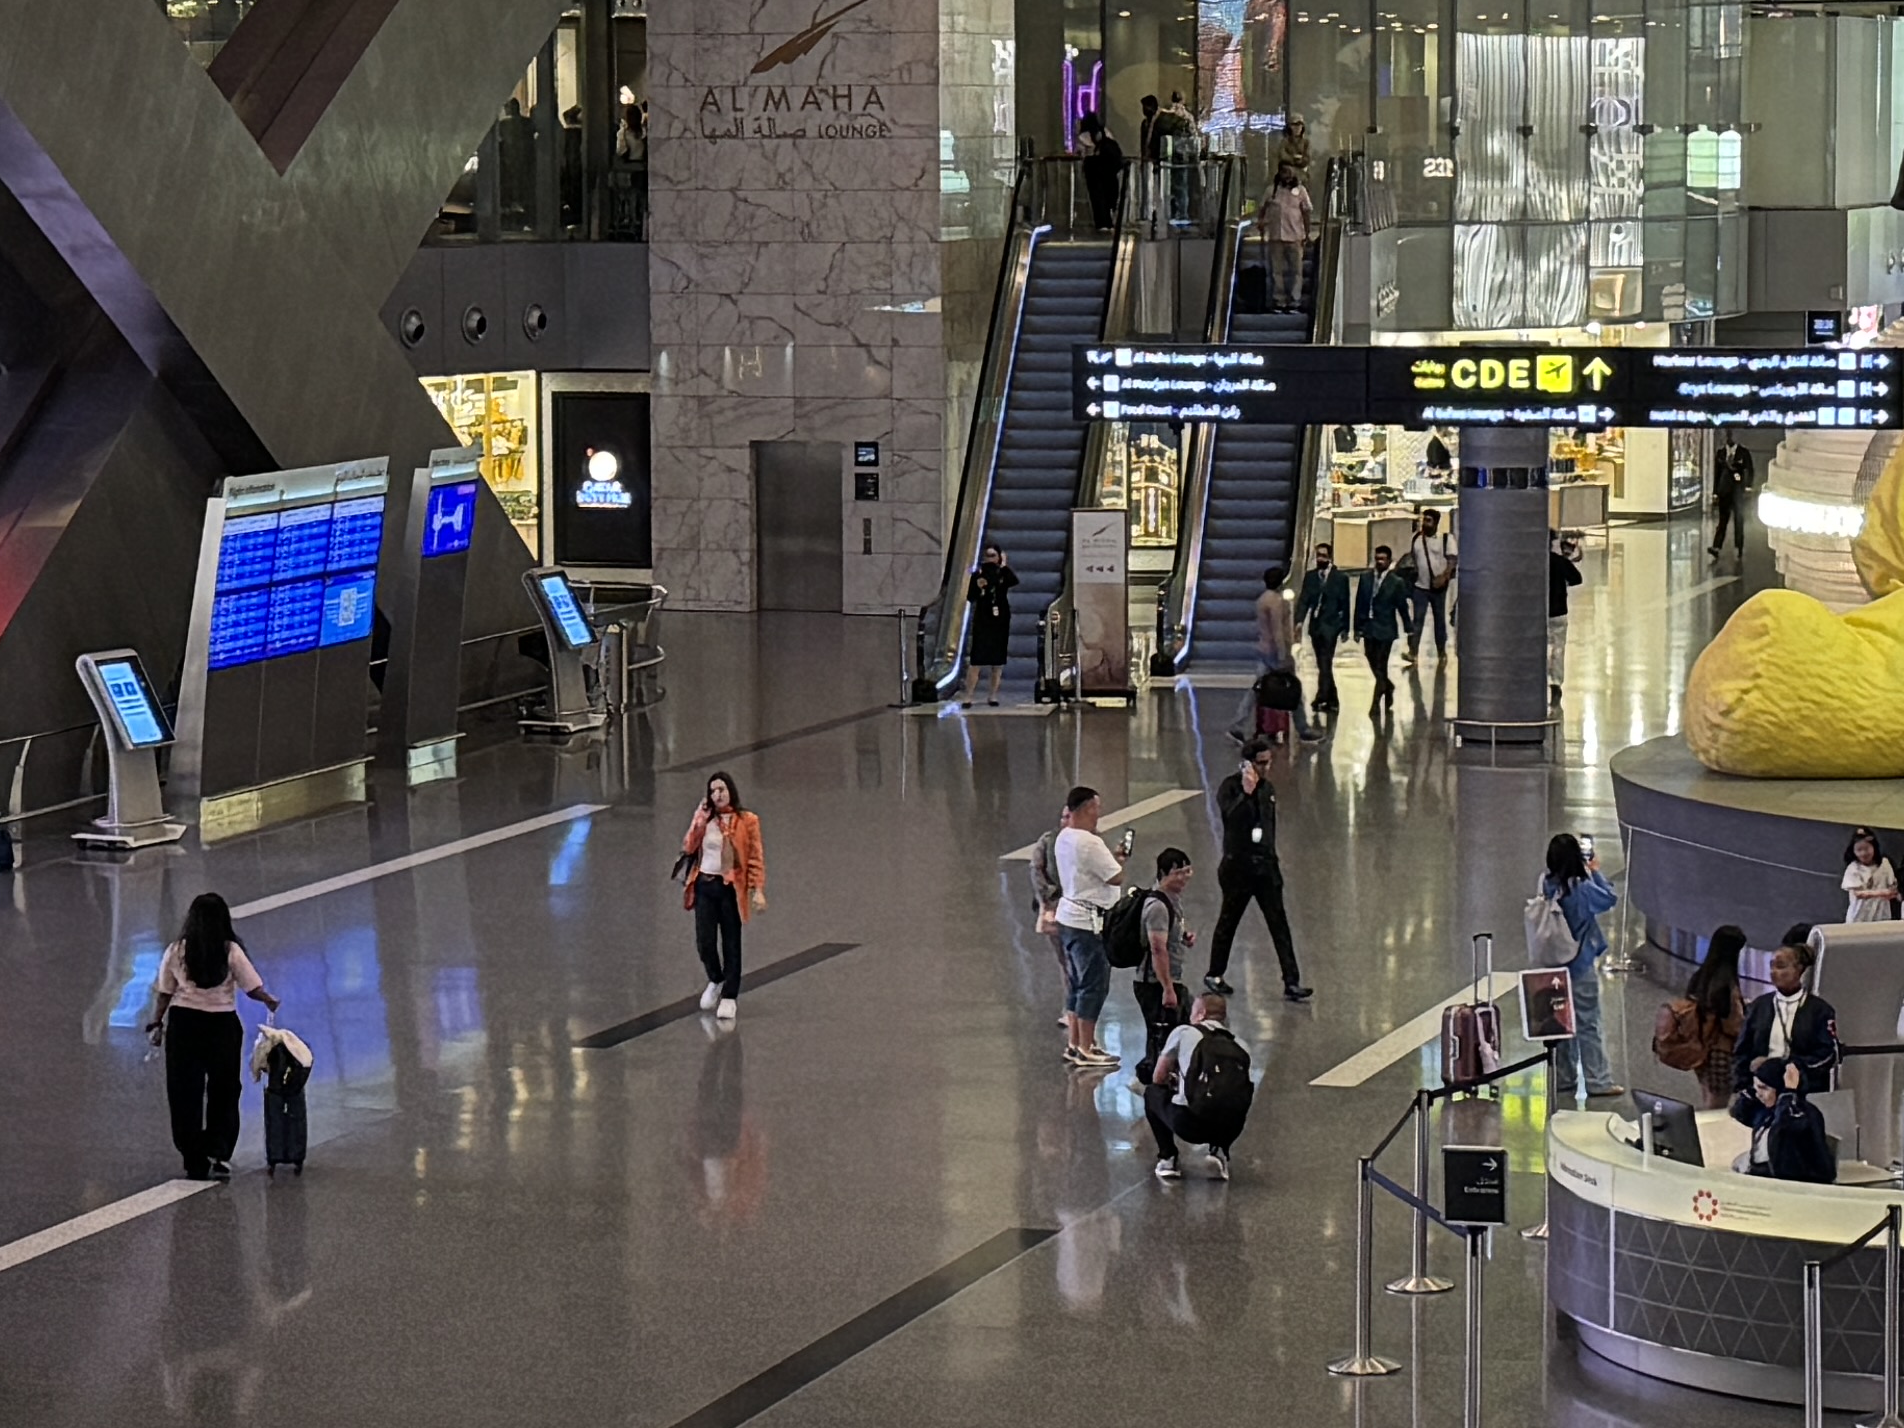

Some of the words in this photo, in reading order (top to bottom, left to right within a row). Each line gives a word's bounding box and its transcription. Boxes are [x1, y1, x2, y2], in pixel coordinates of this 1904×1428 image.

[699, 85, 744, 113] AL
[762, 84, 886, 113] MAHA
[818, 123, 892, 140] LOUNGE
[1451, 358, 1531, 389] CDE
